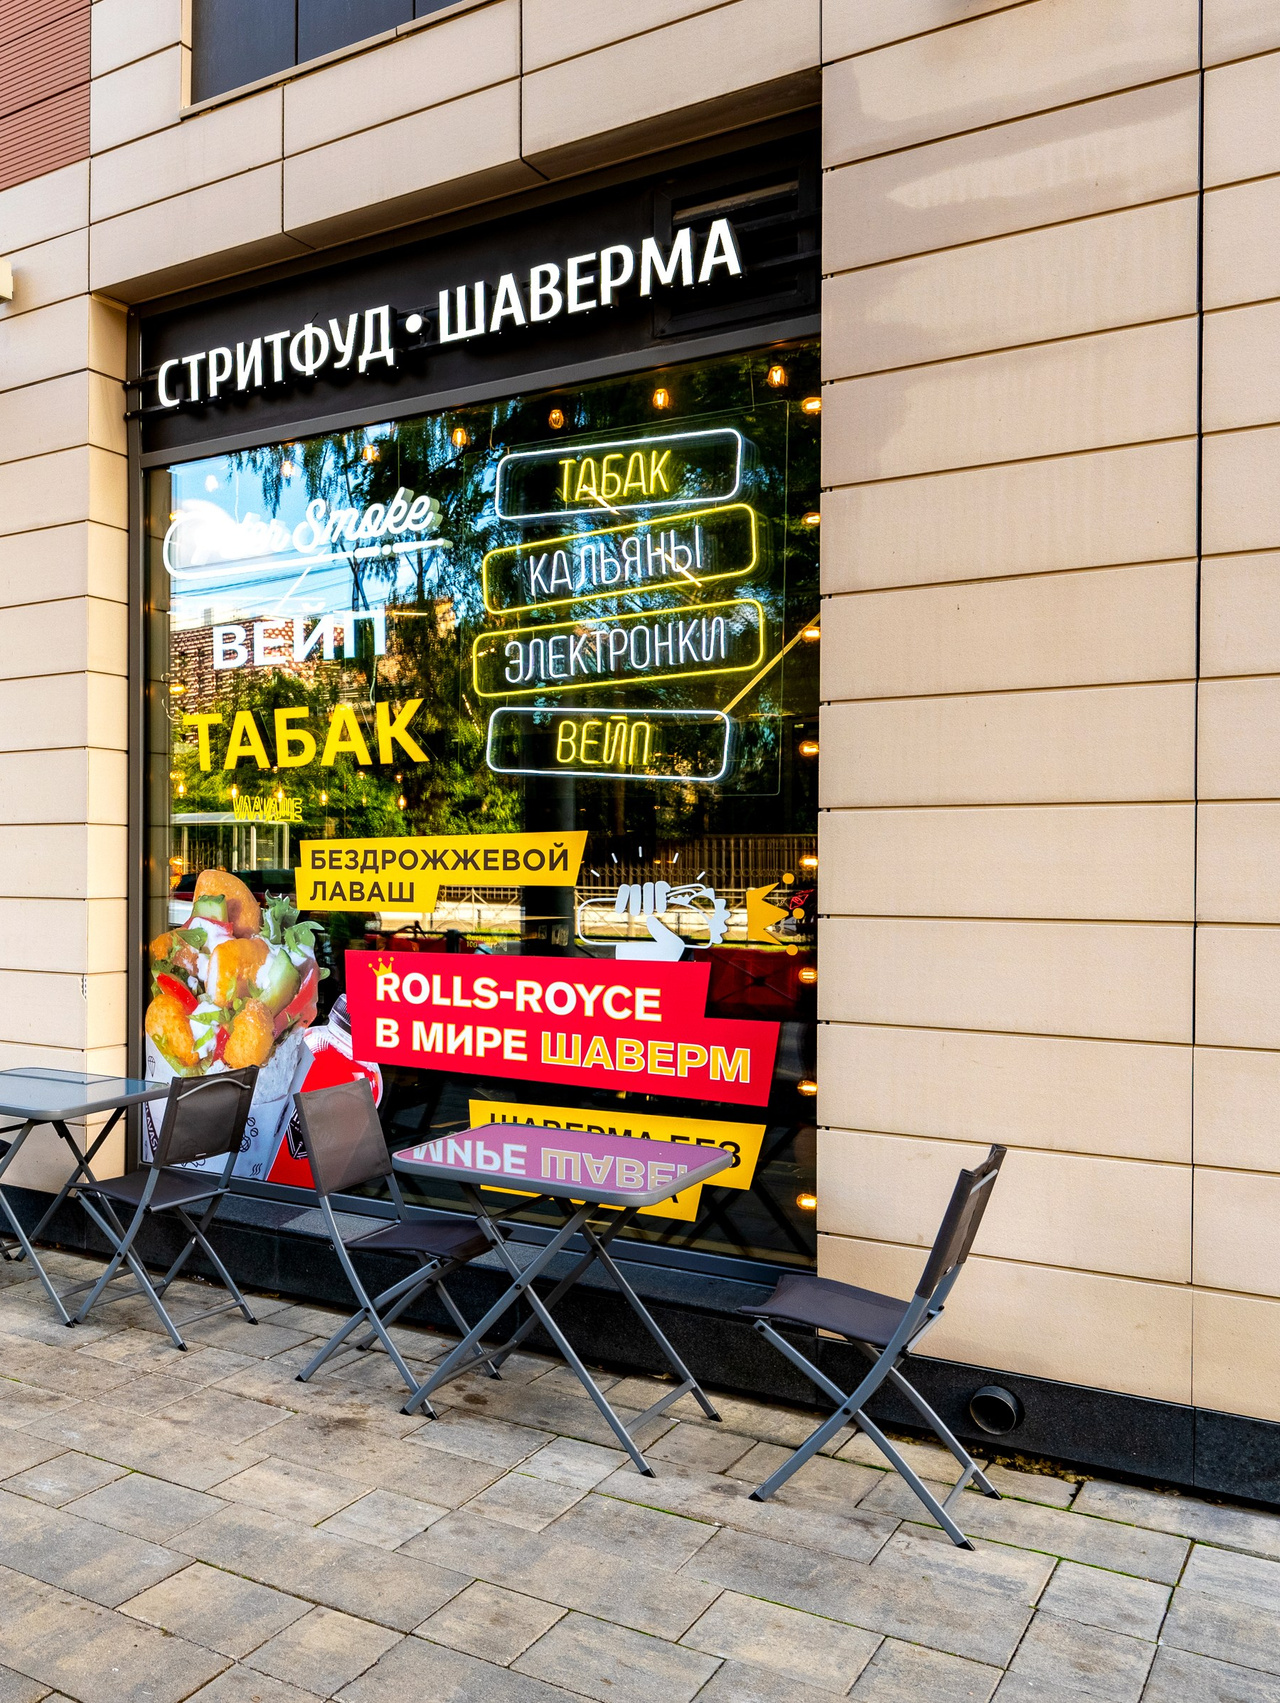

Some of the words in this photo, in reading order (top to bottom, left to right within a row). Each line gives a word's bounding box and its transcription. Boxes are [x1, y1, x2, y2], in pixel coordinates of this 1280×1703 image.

[157, 304, 394, 408] СТРИТФУД
[438, 218, 742, 344] ШАВЕРМА
[558, 449, 672, 503] ТАБАК
[292, 486, 440, 554] Smoke
[528, 525, 703, 595] КАЛЬЯНЫ
[212, 601, 387, 670] ВЕЙП
[504, 615, 727, 684] ЭЛЕКТРОНКИ
[182, 698, 432, 772] ТАБАК
[555, 715, 652, 765] ВЕЙП
[310, 842, 569, 873] БЕЗДРОЖЖЕВОЙ
[310, 881, 415, 903] ЛАВАШ
[375, 971, 663, 1022] ROLLS-ROYCE
[376, 1017, 400, 1049] В
[412, 1020, 528, 1062] МИРЕ
[541, 1031, 751, 1083] ШАВЕРМ
